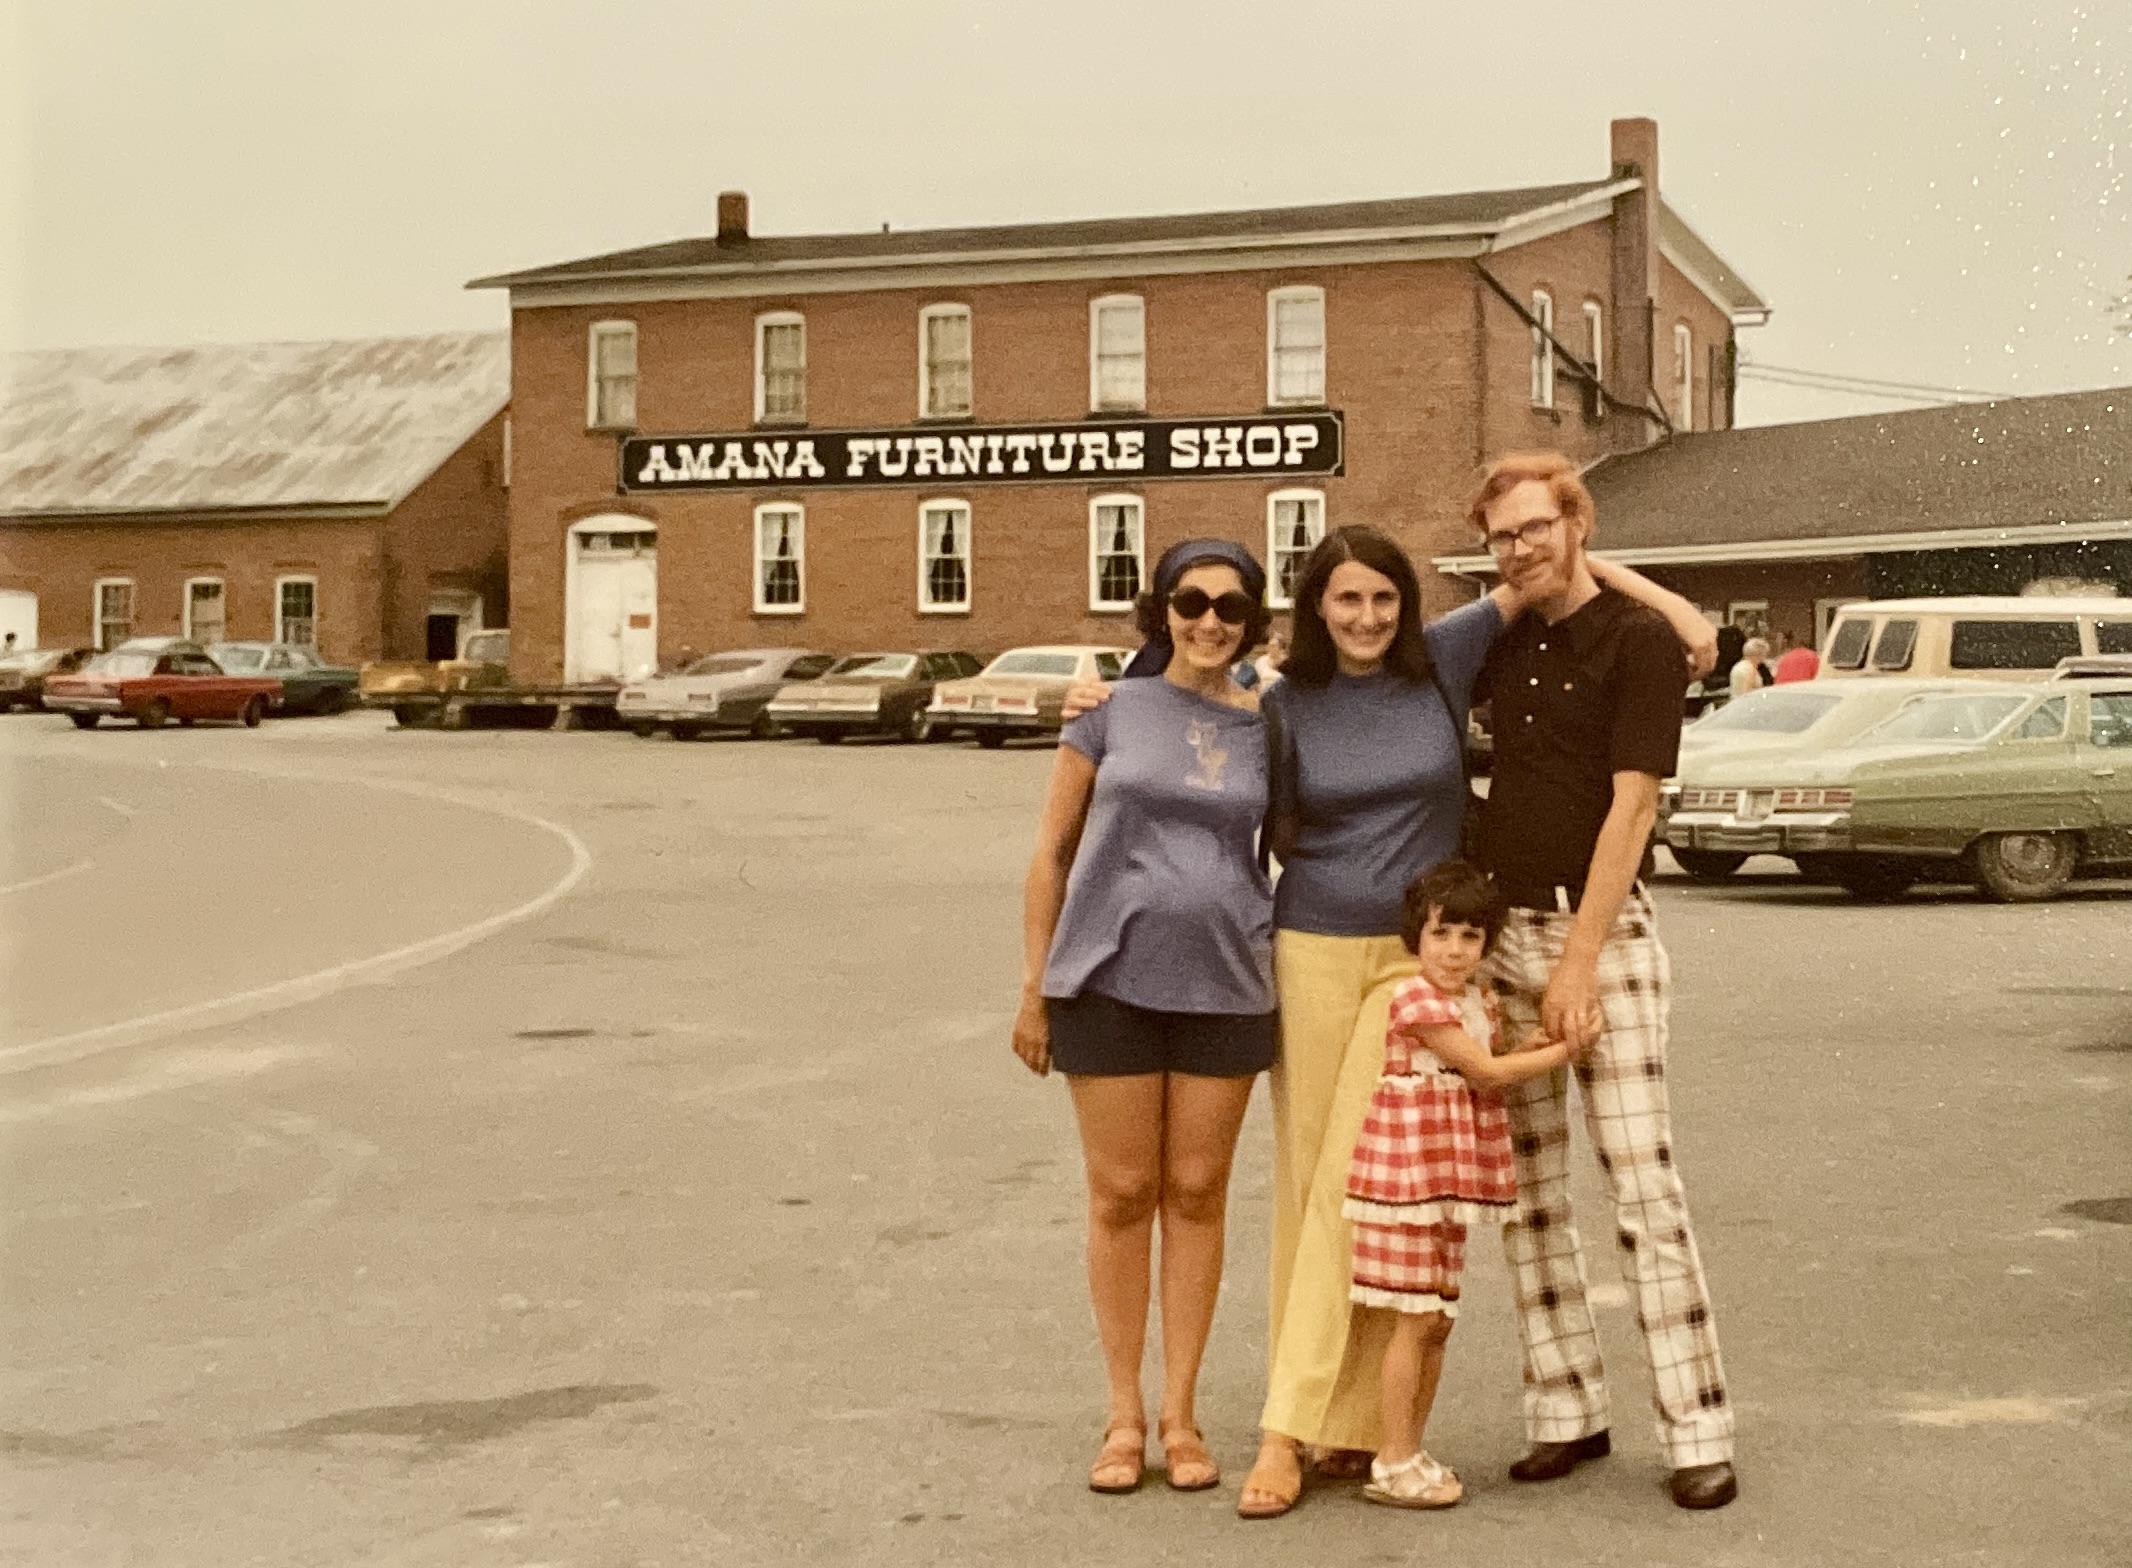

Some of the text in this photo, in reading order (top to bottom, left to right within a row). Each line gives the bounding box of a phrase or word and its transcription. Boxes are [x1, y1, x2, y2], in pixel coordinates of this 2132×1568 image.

[637, 424, 1320, 483] AMANA FURNITURE SHOP
